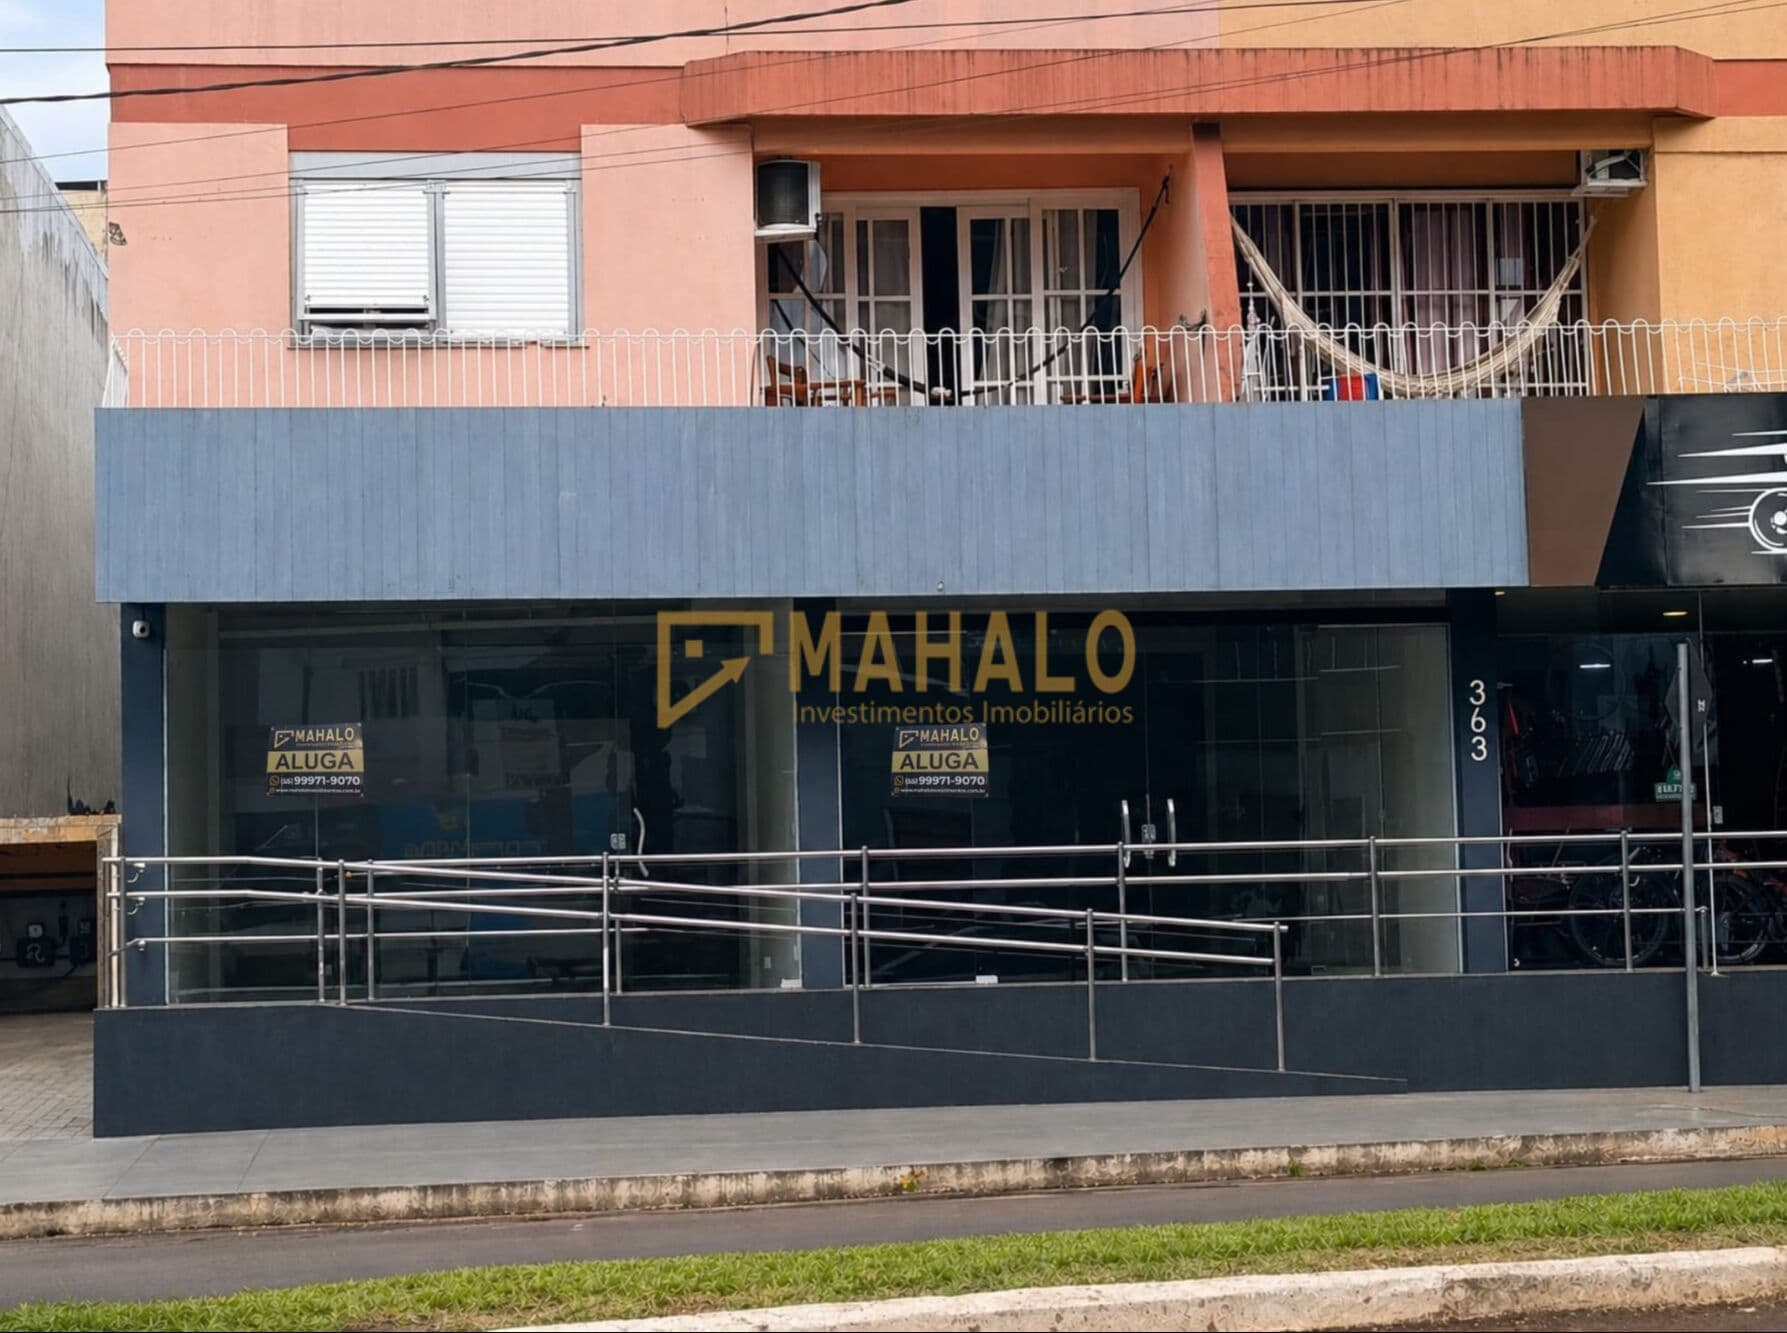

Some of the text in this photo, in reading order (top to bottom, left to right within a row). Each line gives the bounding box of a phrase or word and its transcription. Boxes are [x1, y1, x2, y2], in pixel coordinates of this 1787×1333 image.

[1469, 679, 1488, 762] 363
[295, 727, 354, 742] MAHALO
[920, 727, 979, 742] MAHALO
[275, 752, 354, 769] ALUGA
[899, 752, 979, 770] ALUGA
[294, 776, 361, 786] 99971-9070
[918, 776, 985, 786] 99971-9070
